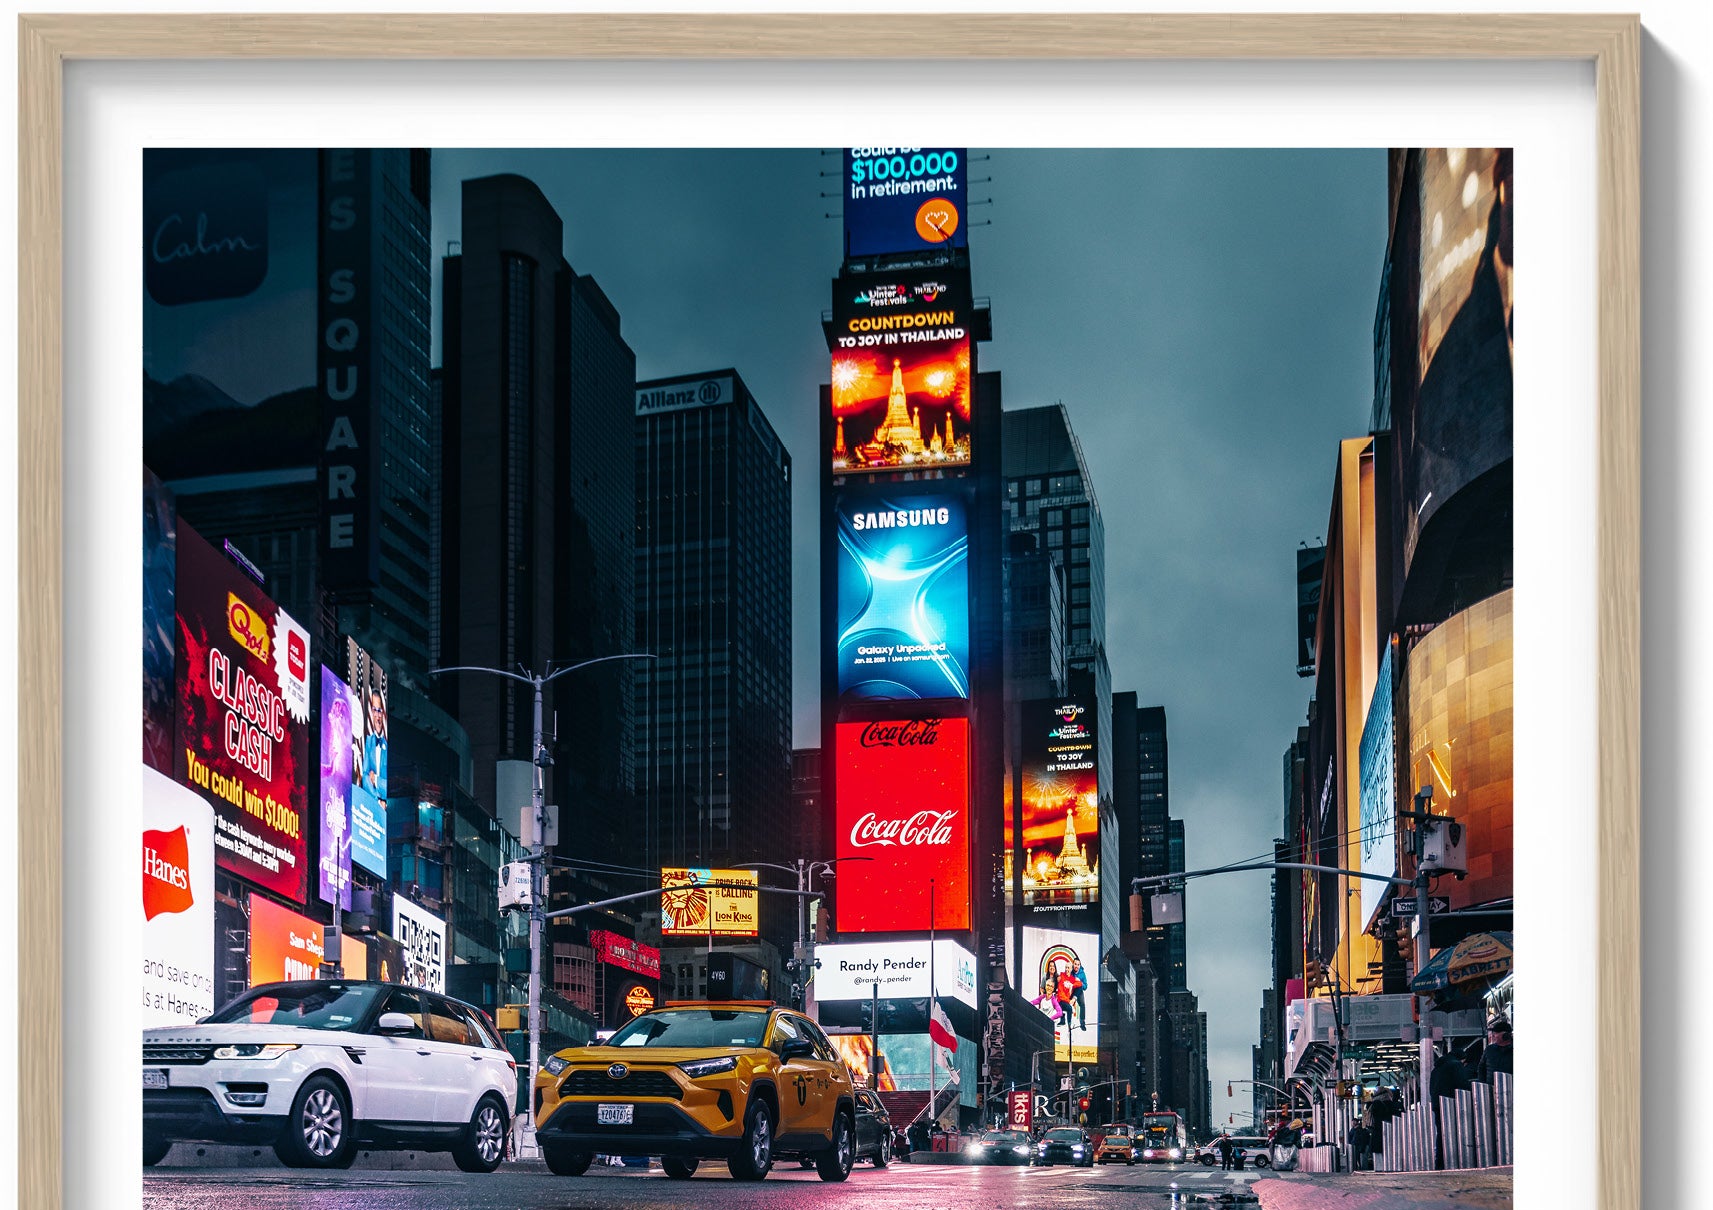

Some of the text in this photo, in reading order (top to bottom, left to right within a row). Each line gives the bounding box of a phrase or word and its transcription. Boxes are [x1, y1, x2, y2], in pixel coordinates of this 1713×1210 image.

[851, 151, 958, 184] $100,000
[851, 175, 958, 199] in retirement.
[152, 212, 262, 263] Calm
[848, 311, 955, 333] COUNTDOWN
[838, 327, 965, 348] TO JOY IN THAILAND
[326, 268, 360, 550] SQUARE
[638, 389, 696, 411] Allianz
[853, 507, 950, 531] SAMSUNG
[857, 642, 946, 656] Galaxy Unpacked
[209, 647, 285, 743] CLASSIC
[225, 710, 272, 783] CASH
[1047, 744, 1092, 753] COUNTDOWN
[1068, 752, 1083, 761] JOY
[1047, 762, 1094, 772] IN THAILAND
[186, 748, 210, 790] You
[211, 771, 243, 809] could
[245, 788, 264, 820] win
[265, 793, 299, 840] $1,000!
[217, 814, 228, 832] the
[227, 822, 241, 838] cash
[214, 832, 235, 851] etween
[252, 850, 262, 865] and
[143, 846, 188, 890] Hanes
[721, 887, 753, 899] CALLING
[289, 931, 305, 950] Sam
[143, 959, 164, 978] and
[167, 966, 189, 986] save
[192, 973, 204, 988] on
[711, 970, 726, 981] 4Y60
[840, 957, 927, 973] Randy Pender
[1451, 956, 1512, 981] SABRETT
[854, 975, 912, 986] @randy_pender
[154, 993, 164, 1011] at
[1014, 1093, 1029, 1124] tkts
